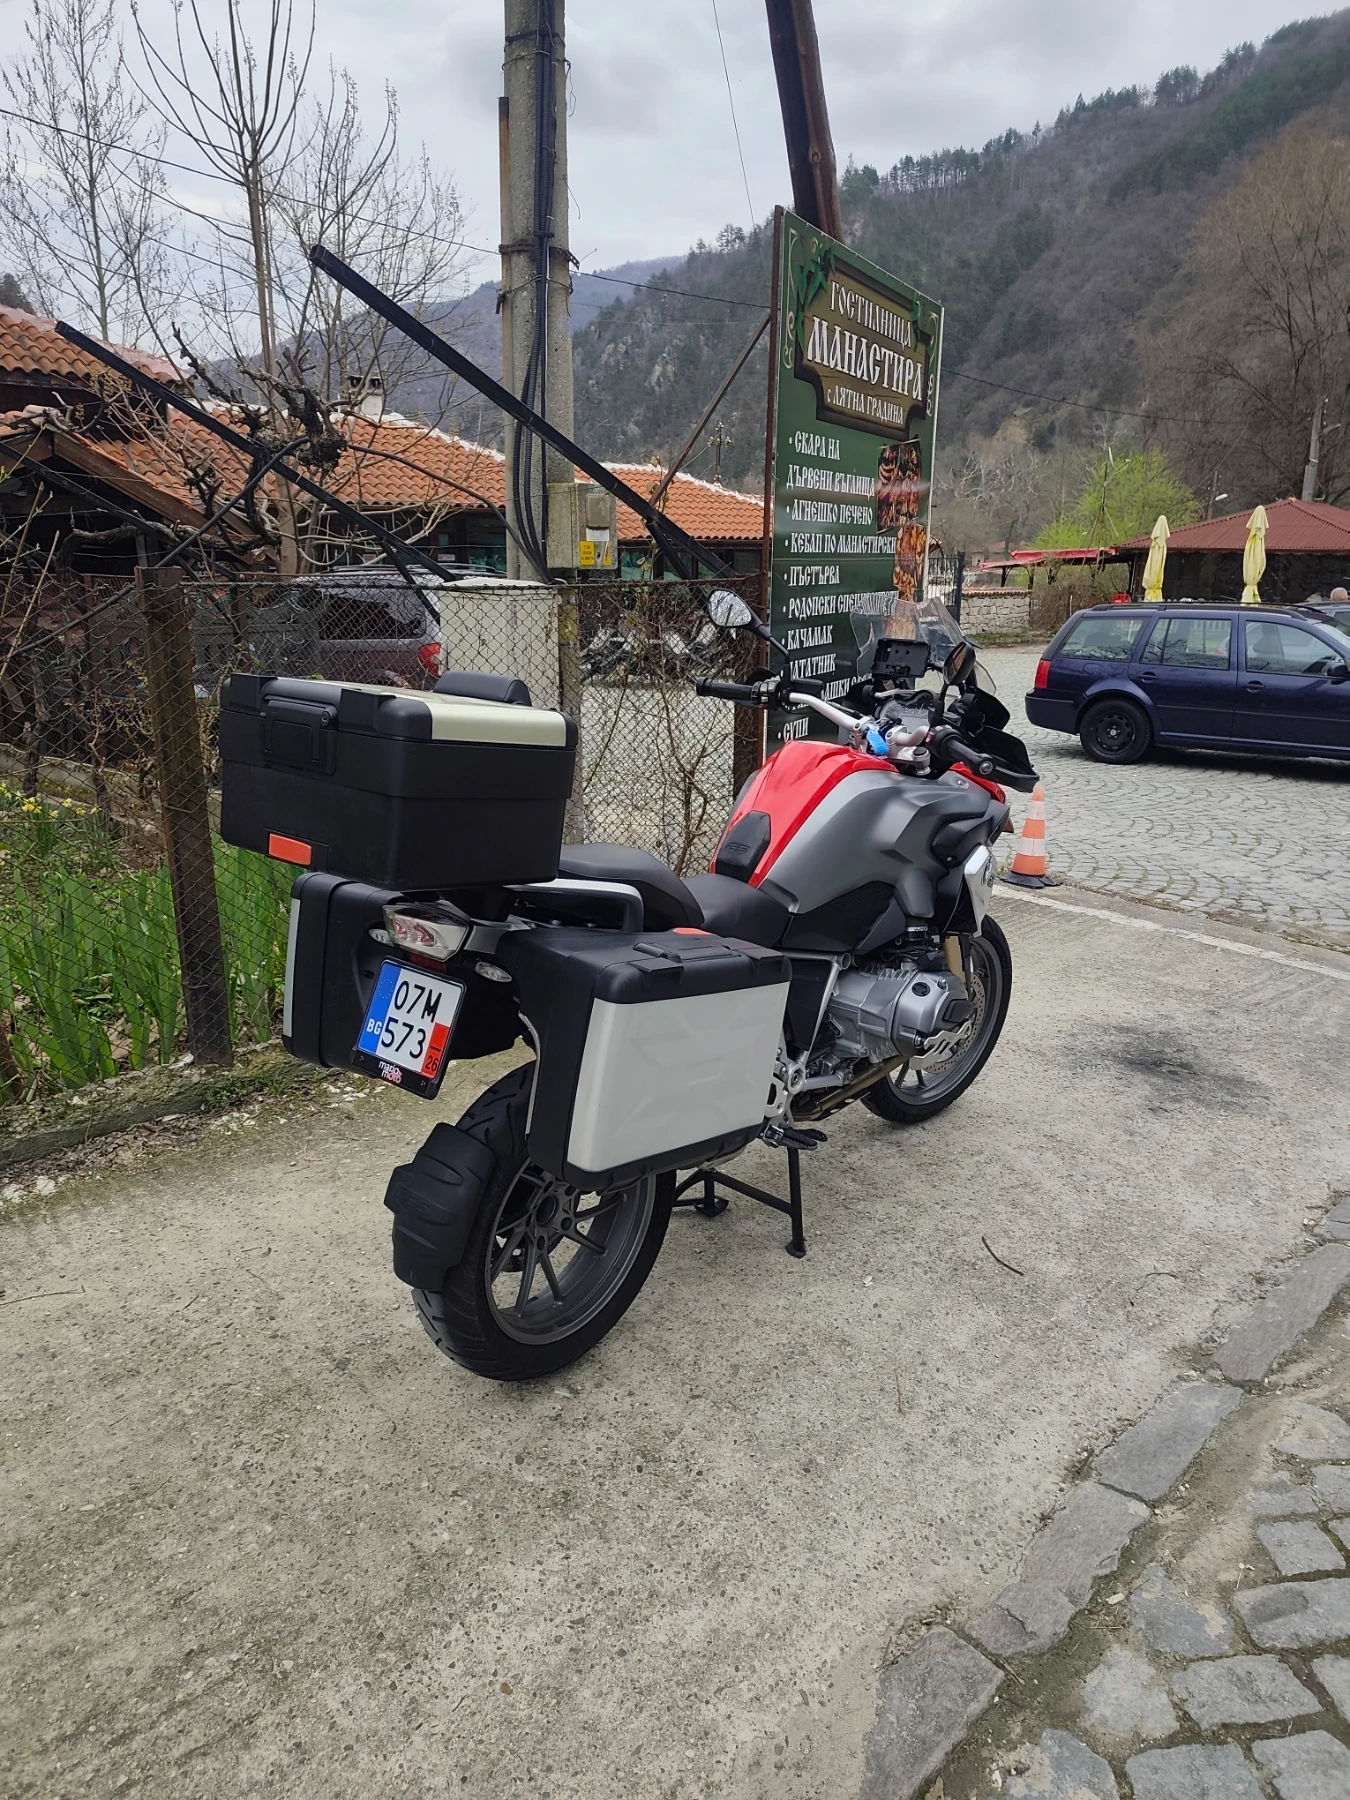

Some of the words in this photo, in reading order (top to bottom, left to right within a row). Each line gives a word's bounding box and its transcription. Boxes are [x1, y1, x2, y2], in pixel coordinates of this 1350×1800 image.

[830, 281, 912, 349] ГОСТИЛНИЦА
[807, 316, 923, 401] МАНАСТИРА
[833, 385, 865, 413] ЛЯТНА
[866, 396, 904, 425] ГРАДИНА
[794, 430, 826, 458] СКАРА
[828, 439, 841, 461] НА
[786, 464, 833, 491] ДЪРВЕНИ
[834, 472, 875, 501] ВЪГЛИЩА
[791, 499, 838, 523] АГНЕШКО
[839, 504, 873, 526] ПЕЧЕНО
[790, 533, 823, 553] КЕБАП
[824, 533, 836, 554] ПО
[788, 565, 840, 586] ПЪСТЪРВА
[788, 595, 837, 621] РОДОПСКИ
[787, 625, 833, 651] КАЧАМАК
[783, 717, 809, 742] СУПИ
[394, 980, 443, 1023] 07M
[366, 1018, 382, 1035] BG
[380, 1016, 427, 1059] 573
[425, 1055, 438, 1071] 26
